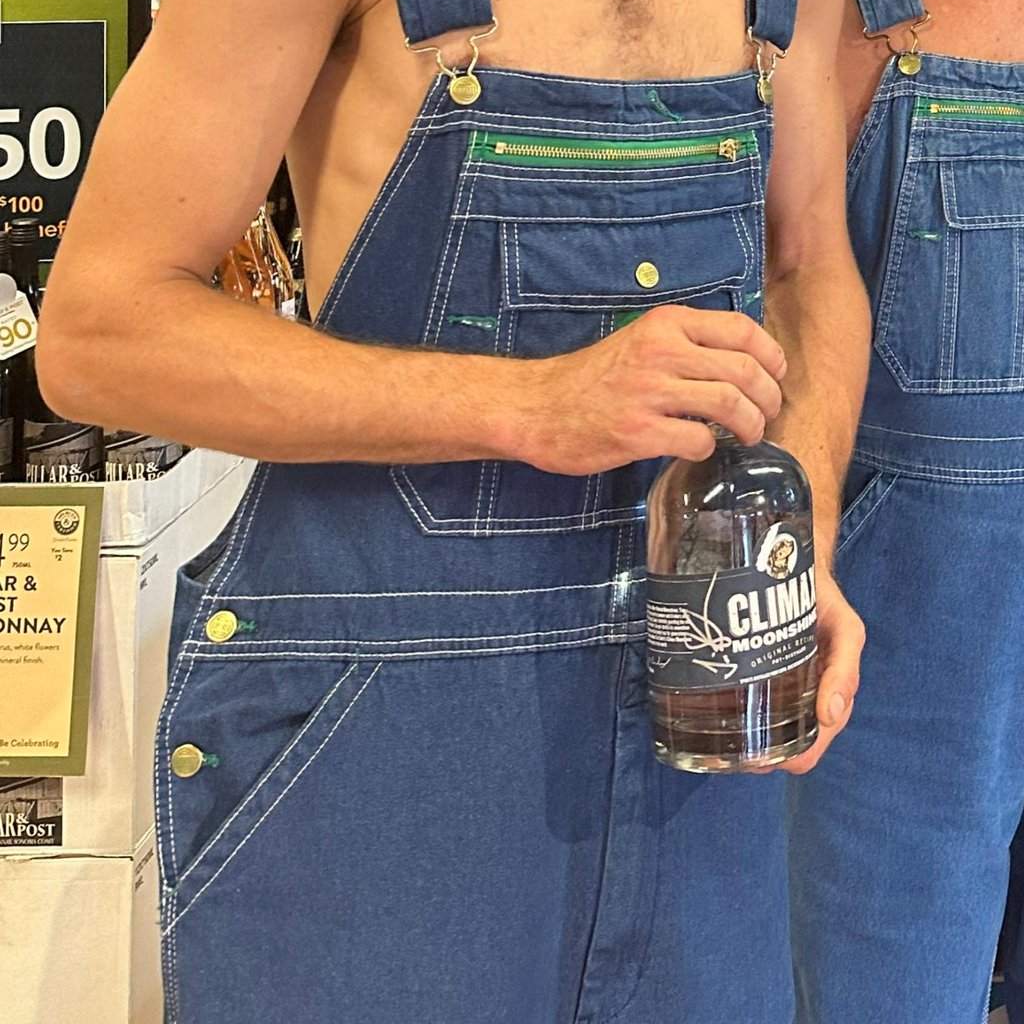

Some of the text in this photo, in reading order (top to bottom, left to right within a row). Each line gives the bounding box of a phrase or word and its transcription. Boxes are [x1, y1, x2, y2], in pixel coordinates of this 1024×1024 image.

[26, 462, 69, 483] PILLAR
[105, 461, 159, 483] PILLAR &
[24, 575, 37, 591] &
[732, 606, 817, 653] MOONSHIN
[751, 643, 792, 668] ORIGINAL
[11, 739, 59, 749] Celebrating
[17, 824, 56, 837] POST
